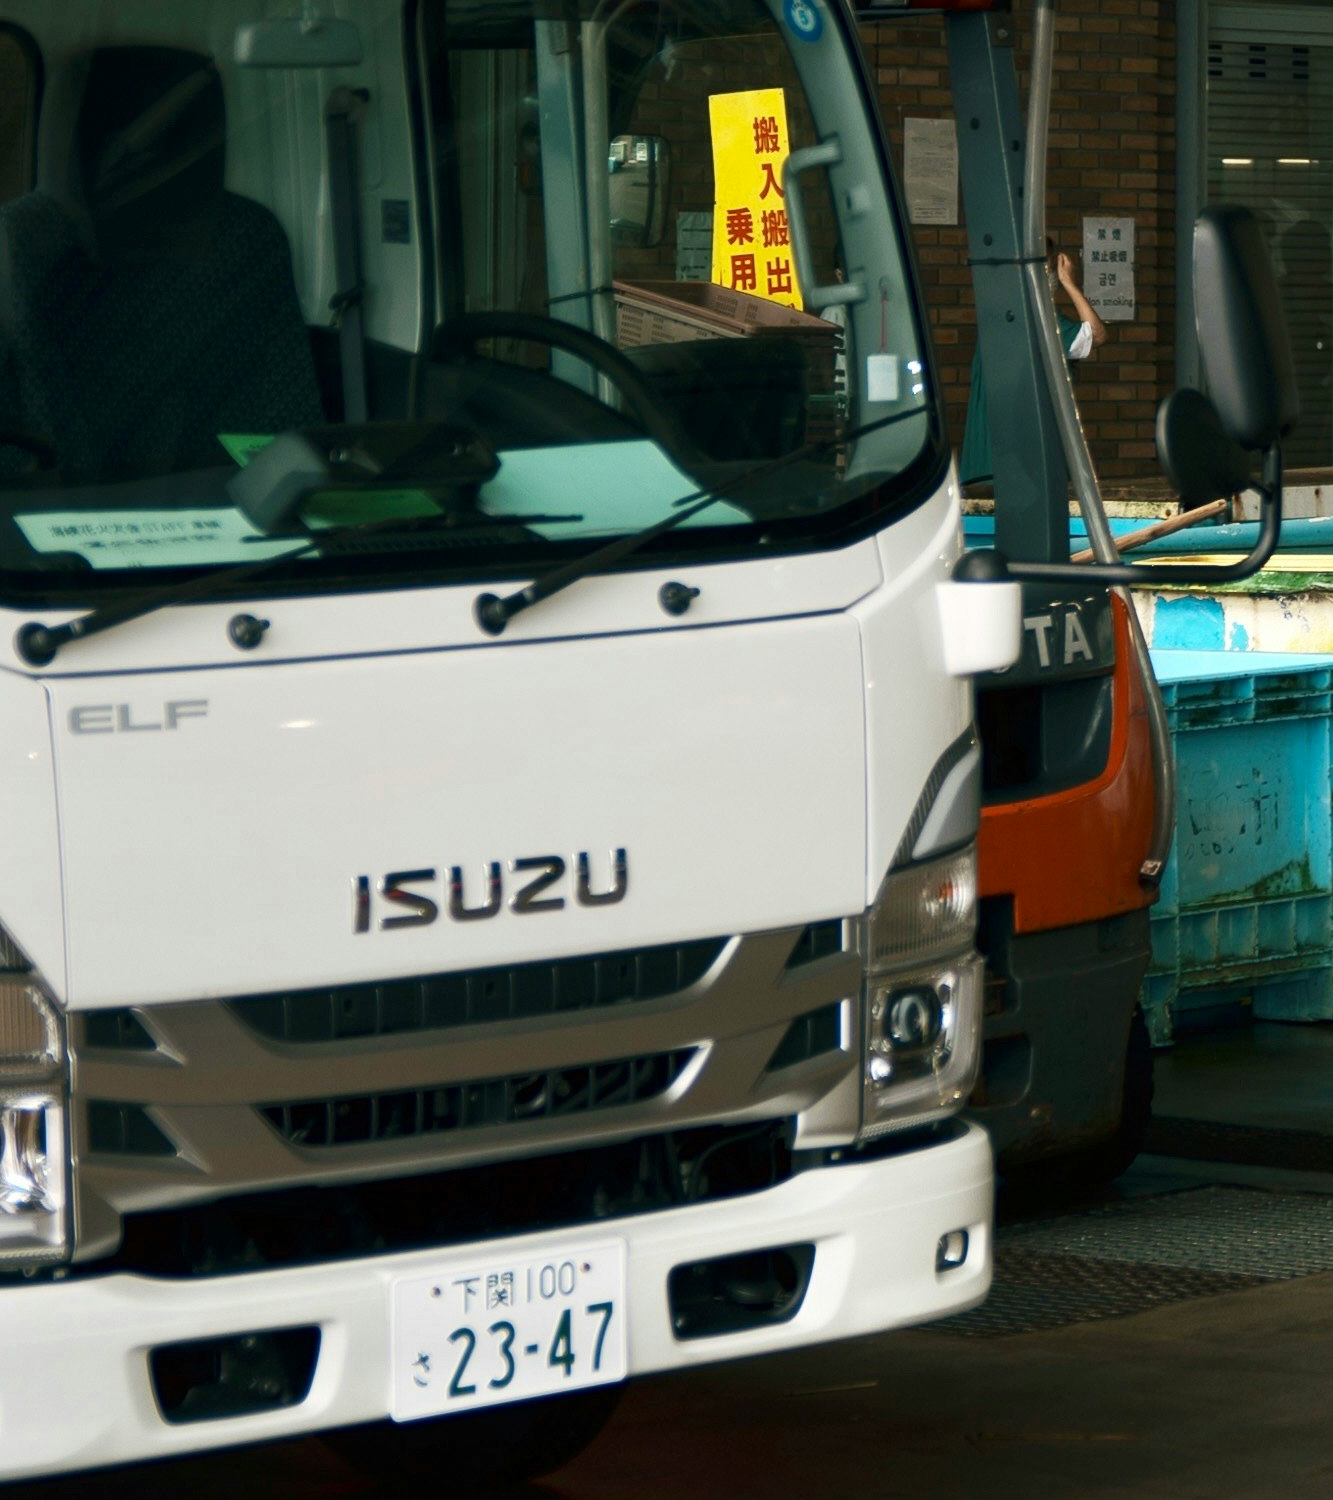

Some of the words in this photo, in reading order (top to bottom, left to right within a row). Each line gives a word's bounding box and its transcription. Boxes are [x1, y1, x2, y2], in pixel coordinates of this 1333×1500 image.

[752, 116, 797, 310] 搬入搬出
[1098, 272, 1117, 287] 금연
[1103, 295, 1133, 308] smoking
[68, 699, 210, 735] ELF
[353, 847, 629, 935] ISUZU
[411, 1352, 433, 1387] さ
[446, 1300, 614, 1398] 23-47
